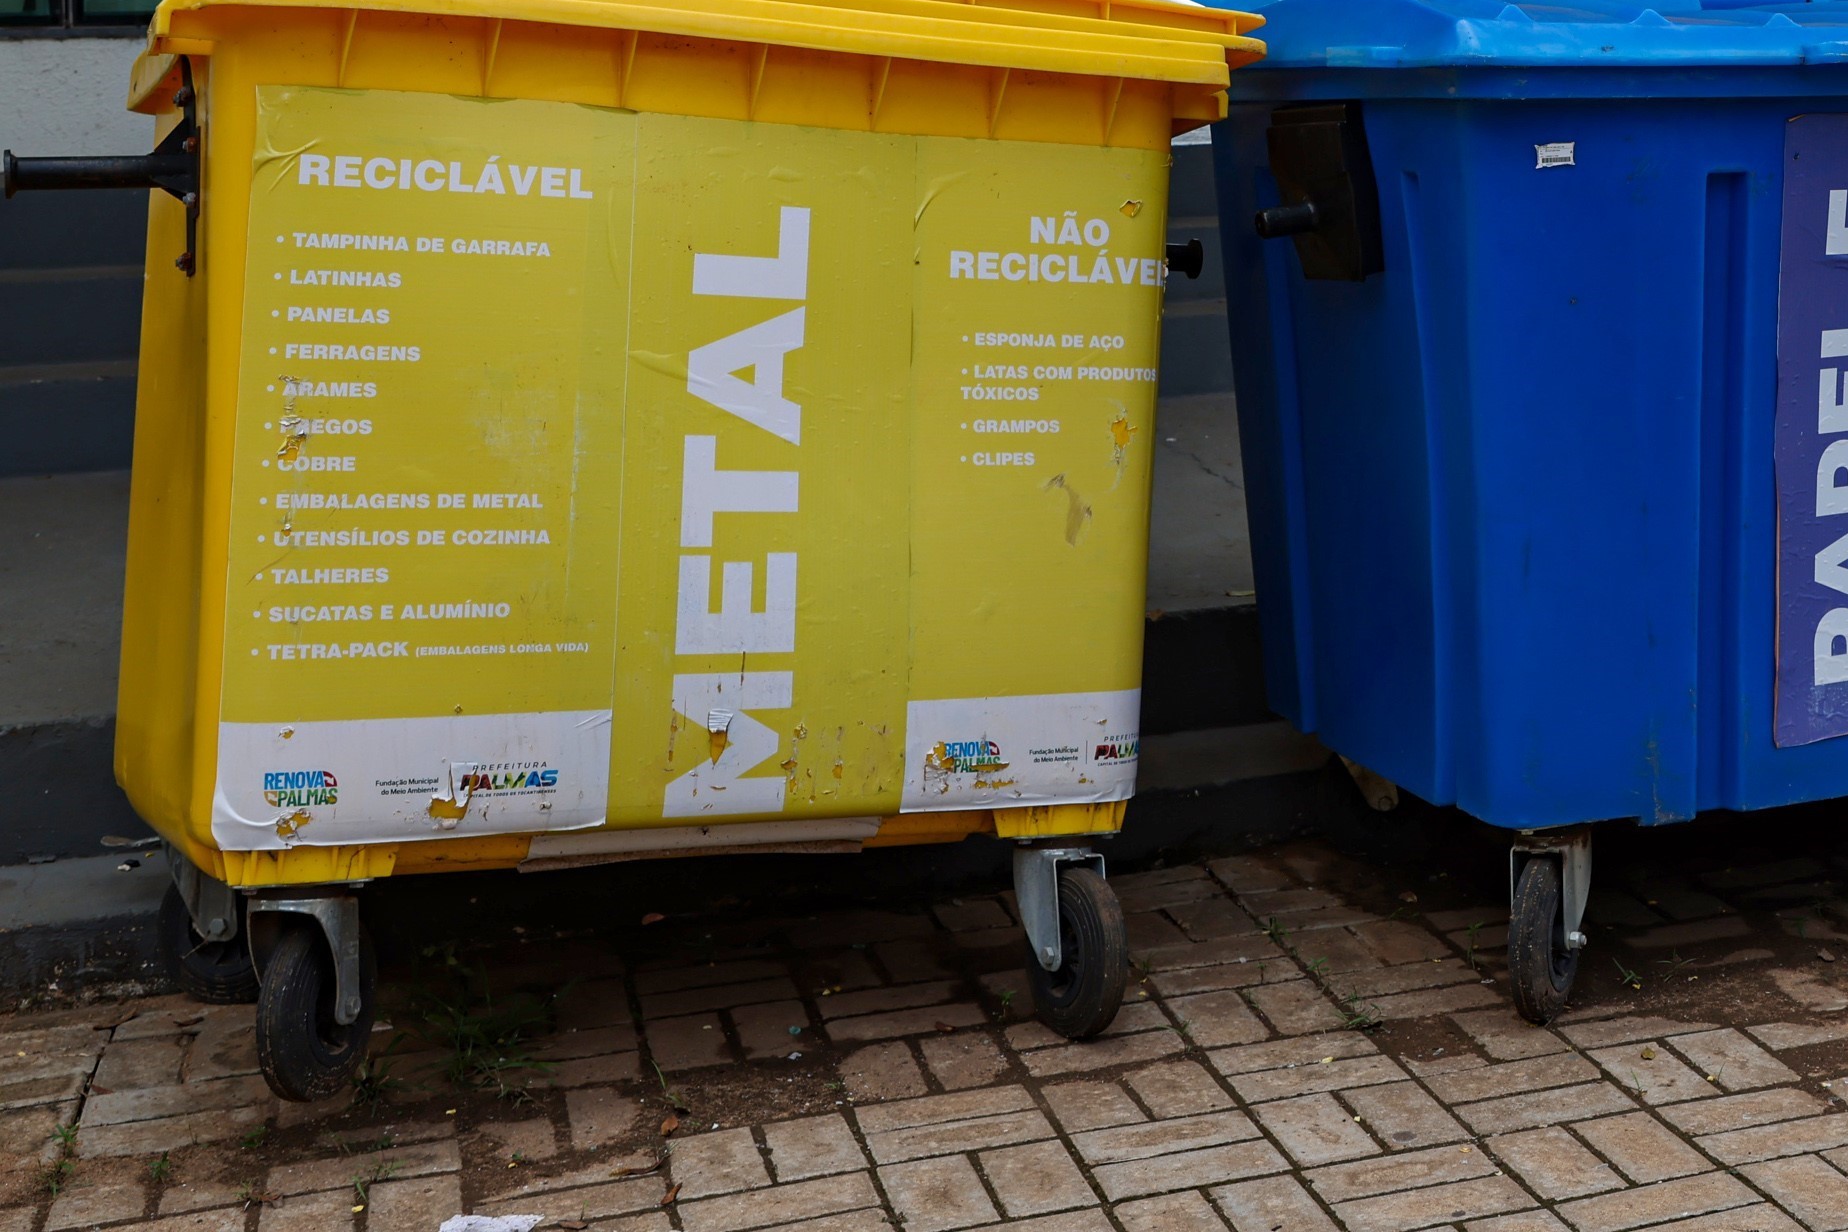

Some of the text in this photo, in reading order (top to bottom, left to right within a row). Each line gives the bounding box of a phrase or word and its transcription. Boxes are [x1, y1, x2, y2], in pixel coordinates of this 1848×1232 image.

[298, 154, 593, 199] RECICLÁVEL
[1030, 210, 1109, 246] NÃO
[293, 232, 550, 257] TAMPINHA DE GARRAFA
[290, 270, 401, 288] LATINHAS
[288, 307, 390, 324] PANELAS
[975, 332, 1124, 352] ESPONJA DE AÇO
[285, 345, 421, 361] FERRAGENS
[974, 366, 1157, 382] LATAS COM PRODUTOS
[283, 382, 377, 397] ARAMES
[961, 384, 1039, 400] TÓXICOS
[973, 420, 1060, 433] GRAMPOS
[972, 452, 1035, 466] CLIPES
[276, 493, 543, 509] EMBALAGENS DE METAL
[662, 205, 810, 818] METAL
[274, 527, 550, 546] UTENSÍLIOS DE COZINHA
[272, 569, 389, 584] TALHERES
[268, 599, 511, 622] SUCATAS E ALUMÍNIO
[268, 642, 589, 660] TETRA-PACK (EMBALAGENS LONGA VIDA)
[1029, 748, 1054, 756] Fundação
[472, 761, 547, 771] PREFEITURA
[264, 771, 325, 790] RENOVA
[376, 777, 439, 787] Fundação Municipal
[460, 770, 559, 791] PALMAS
[278, 788, 338, 807] PALMAS
